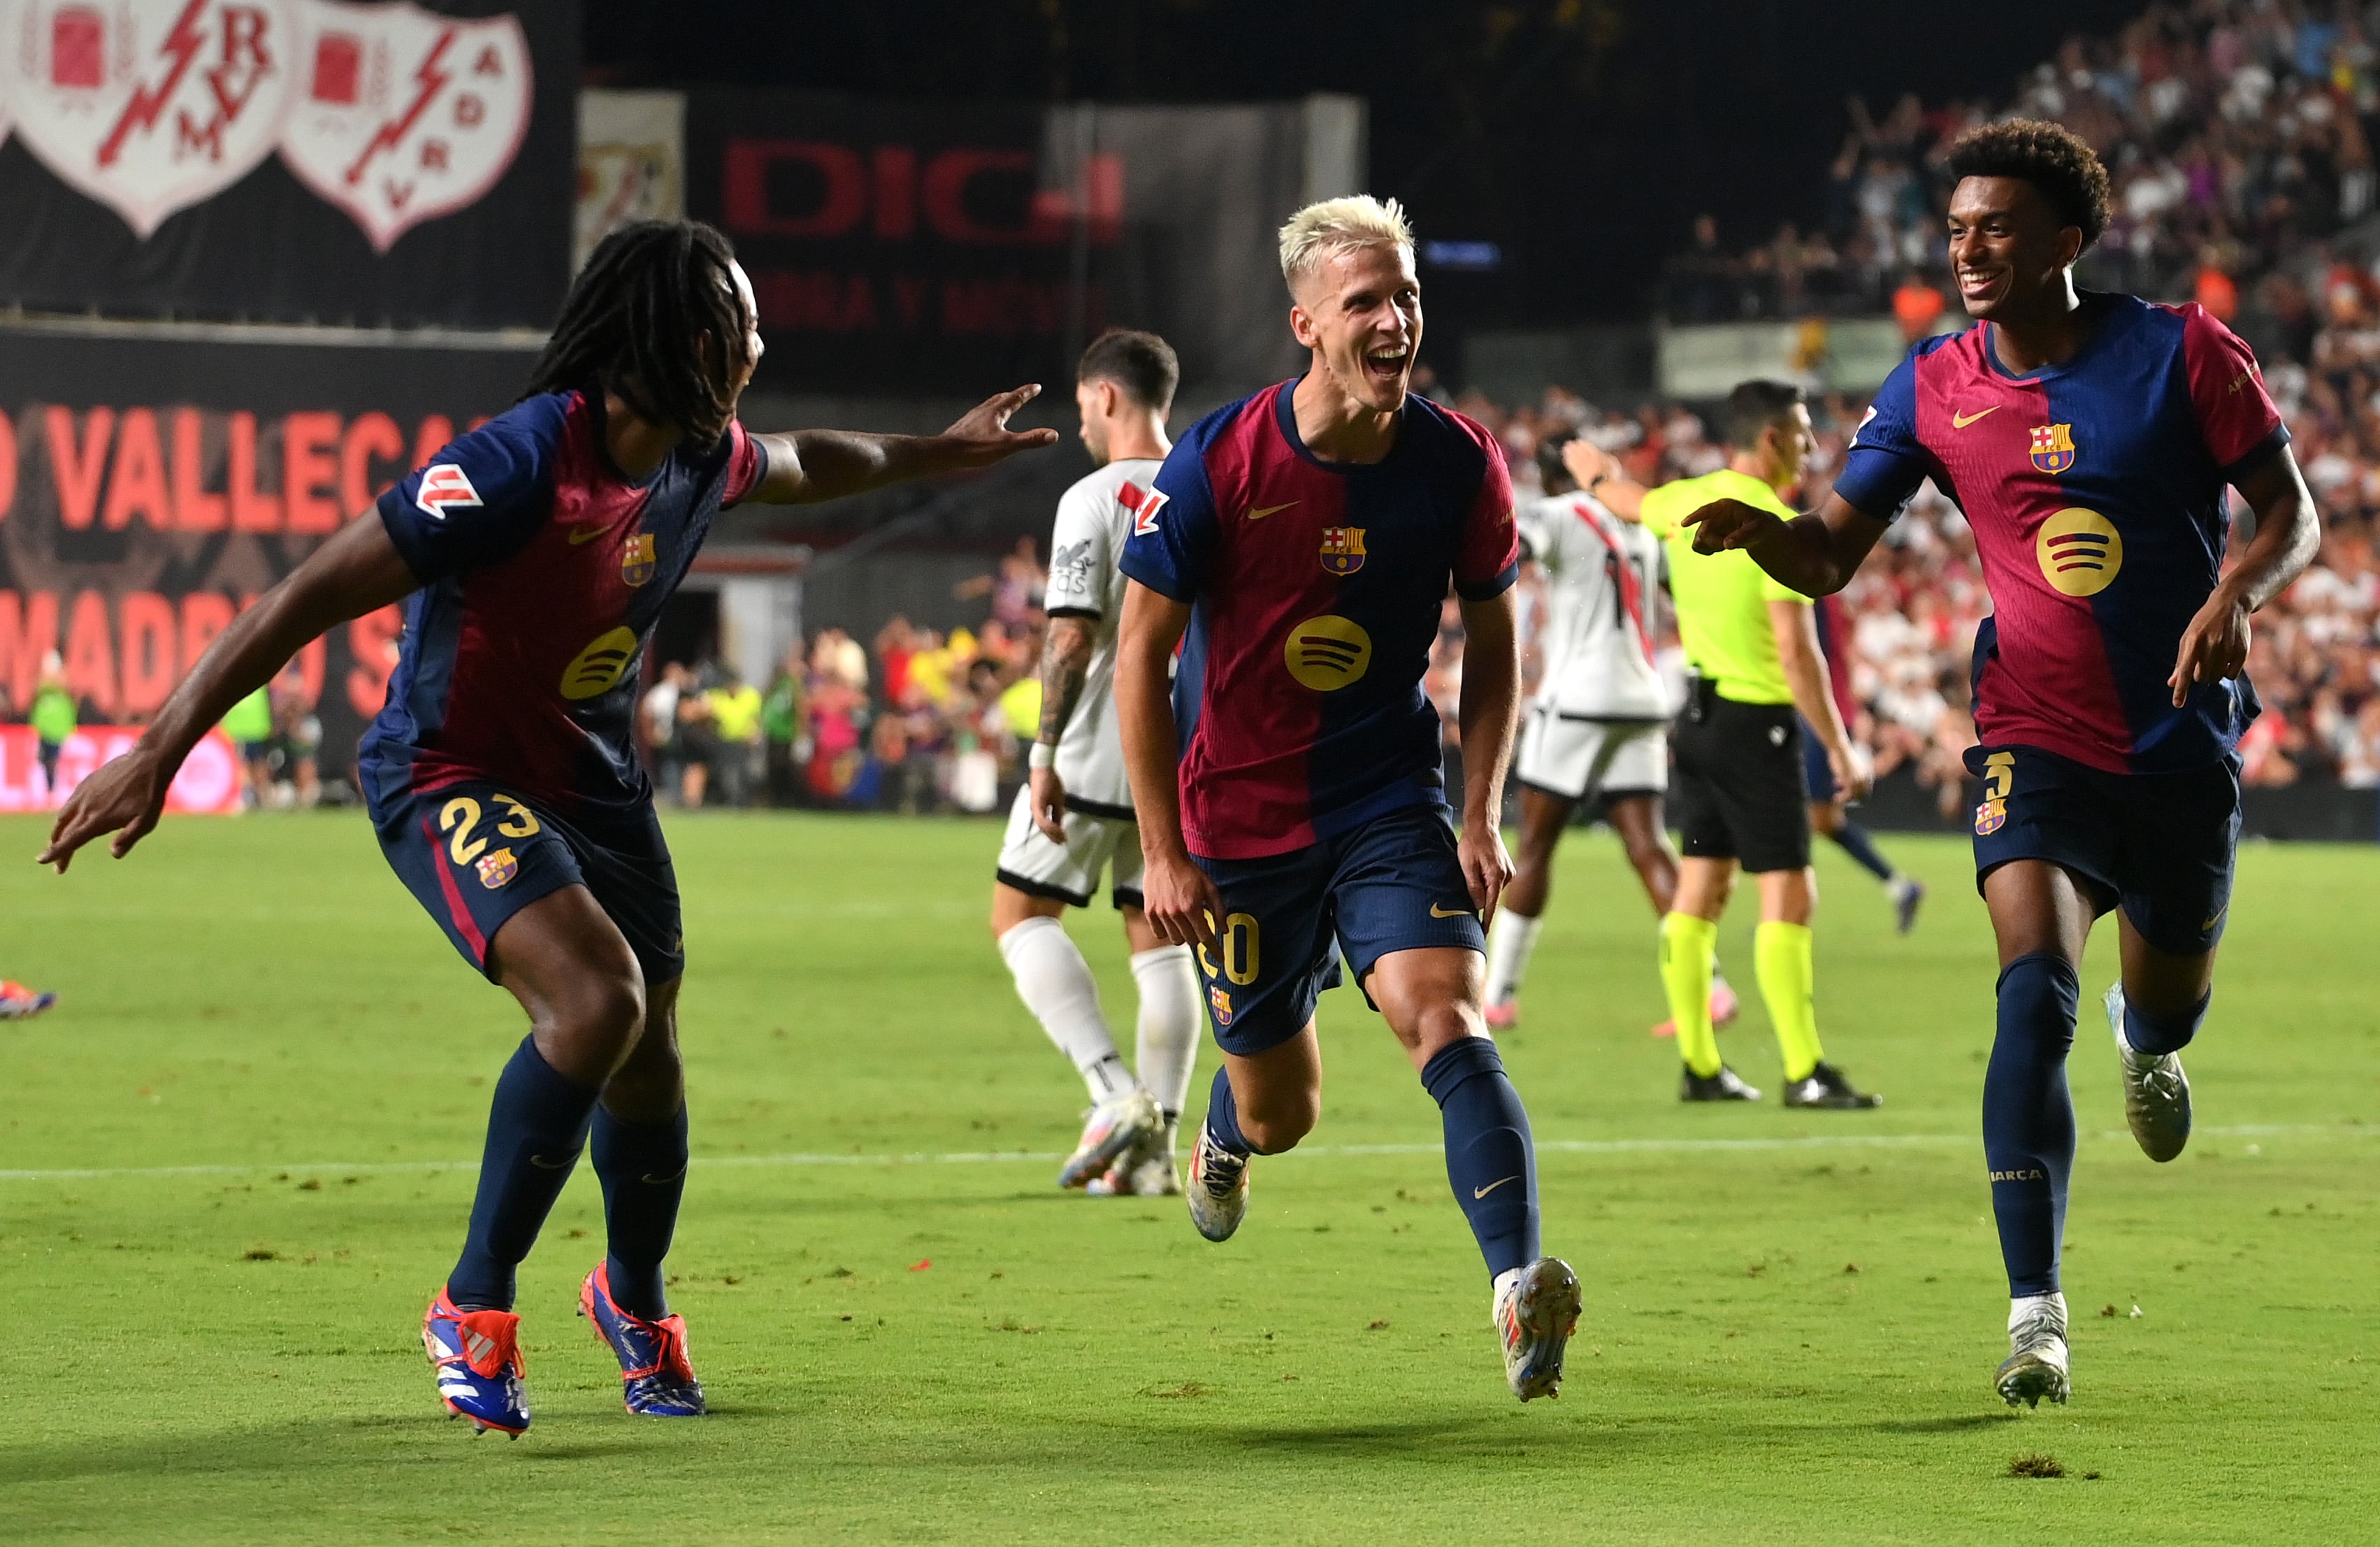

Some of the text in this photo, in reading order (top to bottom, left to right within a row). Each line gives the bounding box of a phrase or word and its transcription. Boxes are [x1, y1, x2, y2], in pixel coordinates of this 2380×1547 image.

[722, 140, 1127, 243] DIGI
[45, 404, 491, 533] VALLEC
[0, 589, 326, 717] MADR
[439, 793, 540, 866] 23
